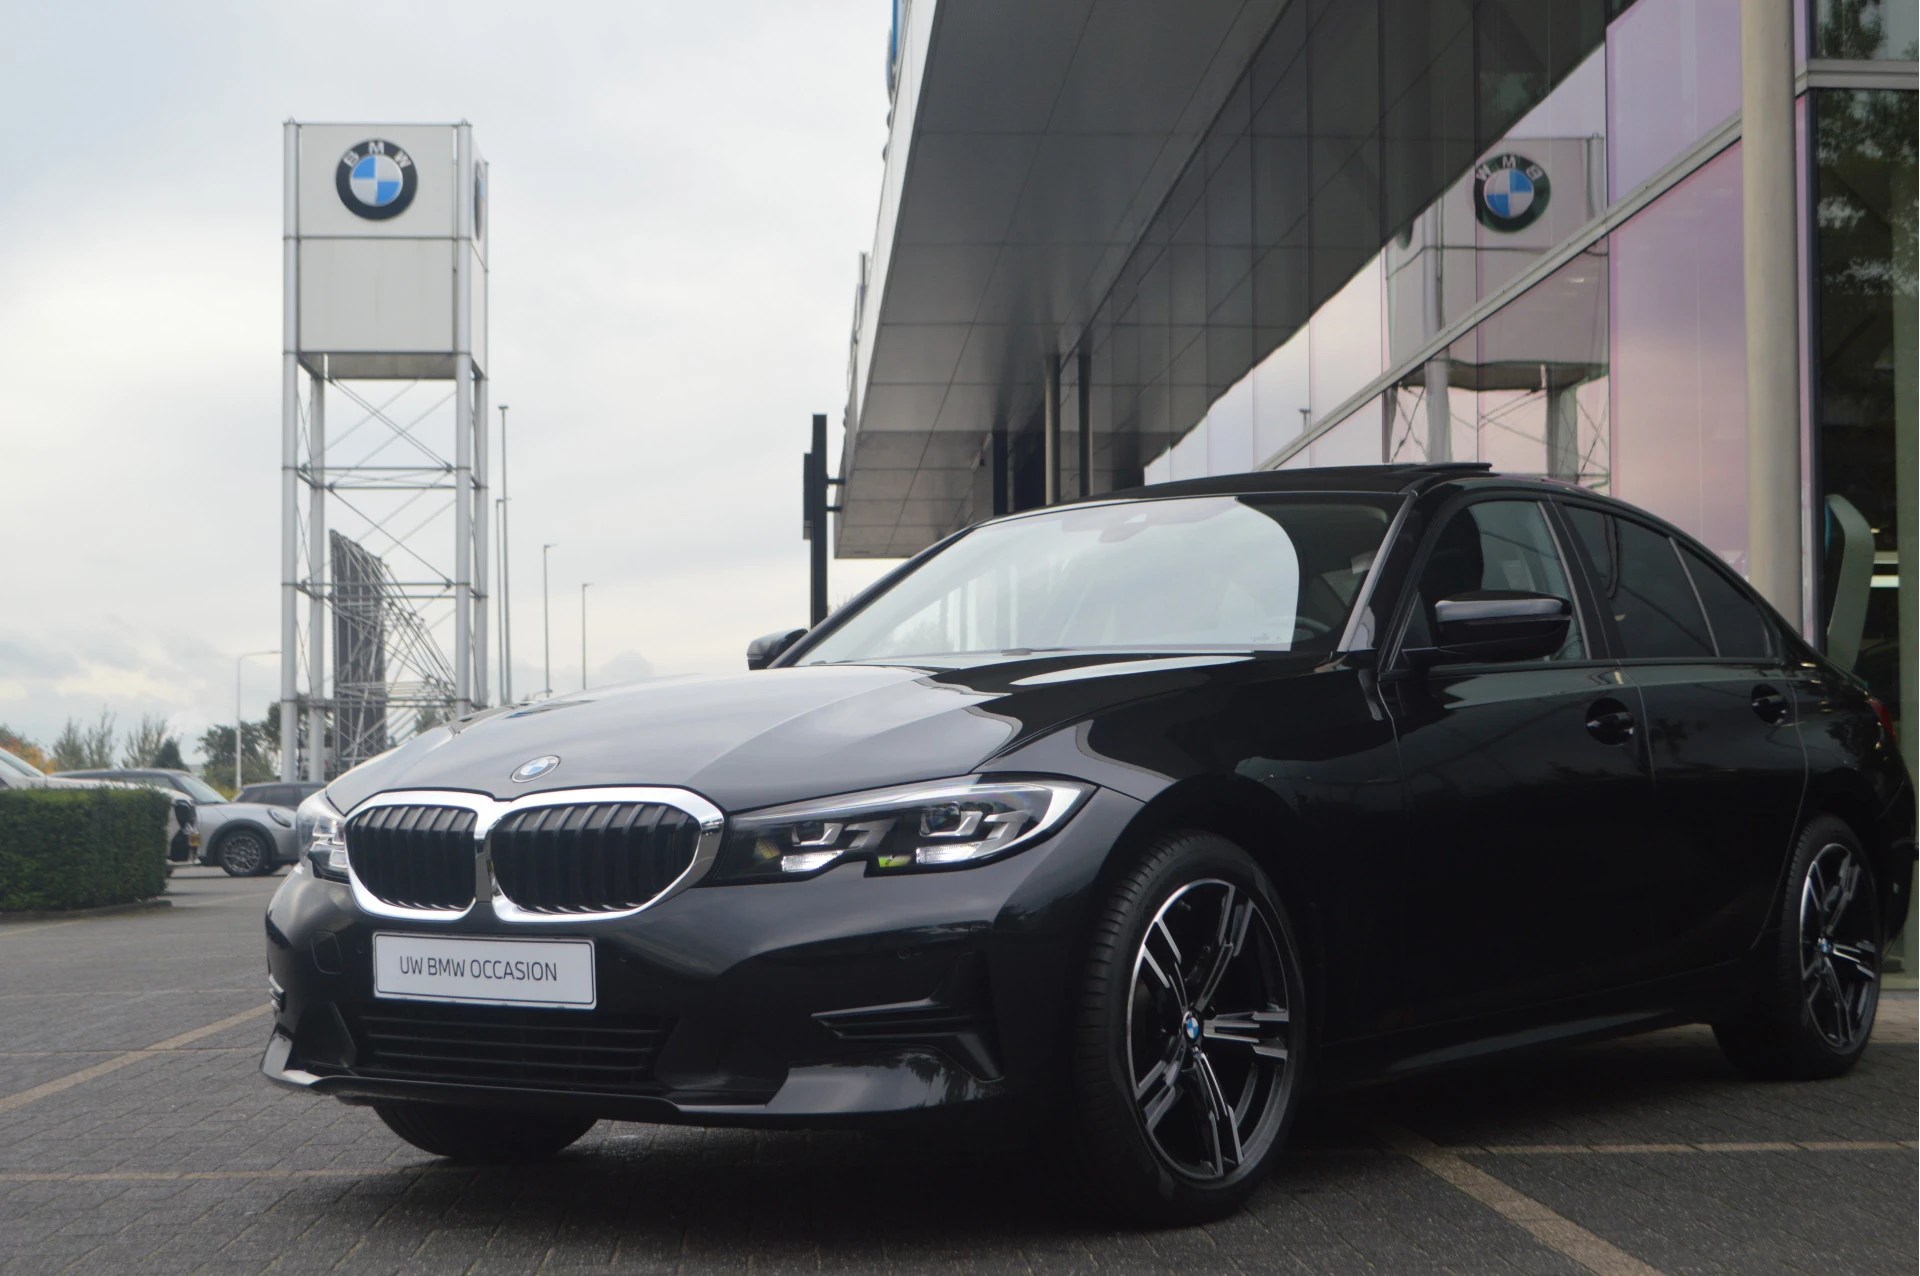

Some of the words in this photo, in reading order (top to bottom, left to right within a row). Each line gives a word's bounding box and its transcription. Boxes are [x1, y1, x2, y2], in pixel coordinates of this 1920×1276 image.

[343, 141, 411, 168] BMW
[400, 955, 424, 975] UW
[428, 957, 466, 977] BMW
[470, 959, 558, 982] OCCASION
